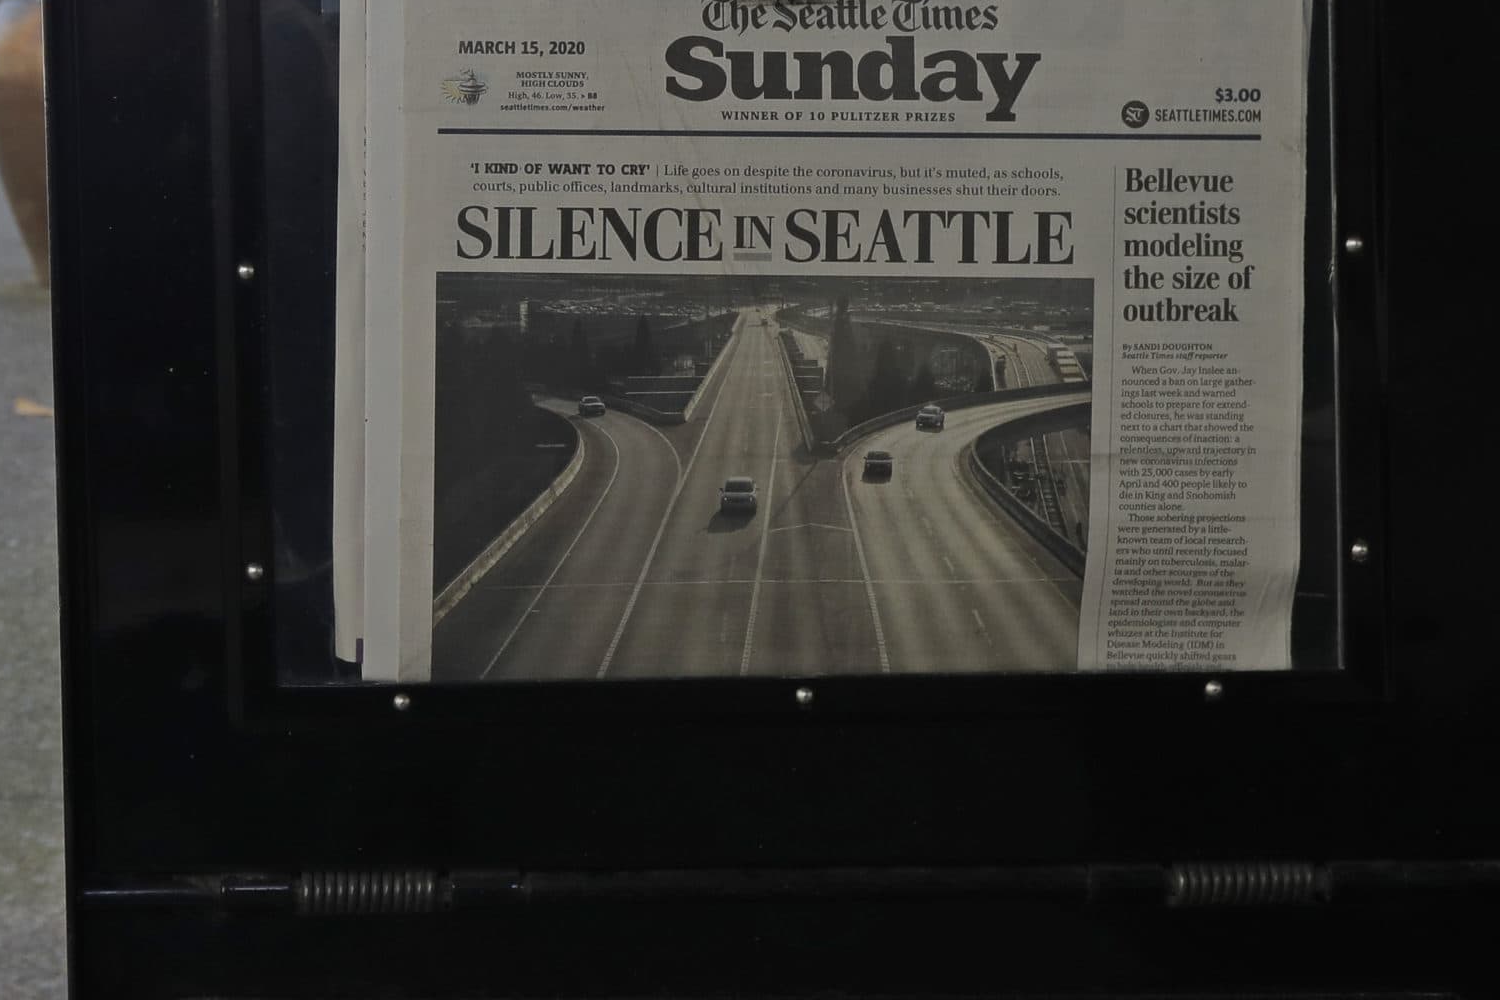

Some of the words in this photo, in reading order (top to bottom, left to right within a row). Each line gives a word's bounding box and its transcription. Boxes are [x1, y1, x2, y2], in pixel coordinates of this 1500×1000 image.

[458, 40, 515, 54] MARCH
[521, 40, 543, 57] 15,
[549, 40, 585, 55] 2020
[516, 71, 553, 80] MOSTLY
[555, 71, 588, 81] SUNNY,
[521, 79, 545, 87] HIGH
[547, 79, 584, 88] CLOUDS
[664, 35, 1041, 124] Sunday
[1215, 87, 1261, 104] $3.00
[500, 103, 604, 111] seattletimes.com/weather
[1154, 108, 1261, 122] SEATTLETIMES.COM
[721, 110, 778, 120] WINNER
[784, 111, 802, 120] OF
[810, 111, 825, 120] 10
[831, 111, 899, 121] PULITZER
[905, 112, 955, 122] PRIZES
[484, 162, 521, 174] KIND
[523, 163, 542, 174] OF
[547, 163, 591, 175] WANT
[596, 163, 615, 175] TO
[664, 164, 688, 176] Life
[691, 167, 720, 179] goes
[723, 167, 739, 176] on
[743, 165, 789, 179] despite
[793, 165, 812, 176] the
[816, 165, 896, 179] coronavirus,
[899, 166, 920, 178] but
[945, 167, 989, 179] muted,
[993, 170, 1007, 178] as
[1011, 167, 1063, 180] schools,
[1125, 167, 1233, 192] Bellevue
[472, 181, 515, 192] courts,
[519, 180, 559, 194] public
[562, 180, 606, 194] offices,
[610, 180, 682, 194] landmarks,
[686, 181, 736, 193] cultural
[740, 182, 812, 194] institutions
[815, 182, 840, 194] and
[843, 185, 878, 196] many
[883, 183, 951, 195] businesses
[955, 183, 983, 195] shut
[987, 183, 1018, 196] their
[1021, 184, 1060, 196] doors.
[1123, 200, 1240, 225] scientists
[456, 205, 723, 262] SILENCE
[733, 215, 775, 250] IN
[784, 208, 1074, 265] SEATTLE
[1123, 232, 1244, 263] modeling
[1123, 265, 1164, 289] the
[1172, 265, 1220, 290] size
[1227, 265, 1255, 289] of
[1123, 297, 1239, 322] outbreak
[1122, 343, 1132, 351] By
[1175, 352, 1195, 360] staff
